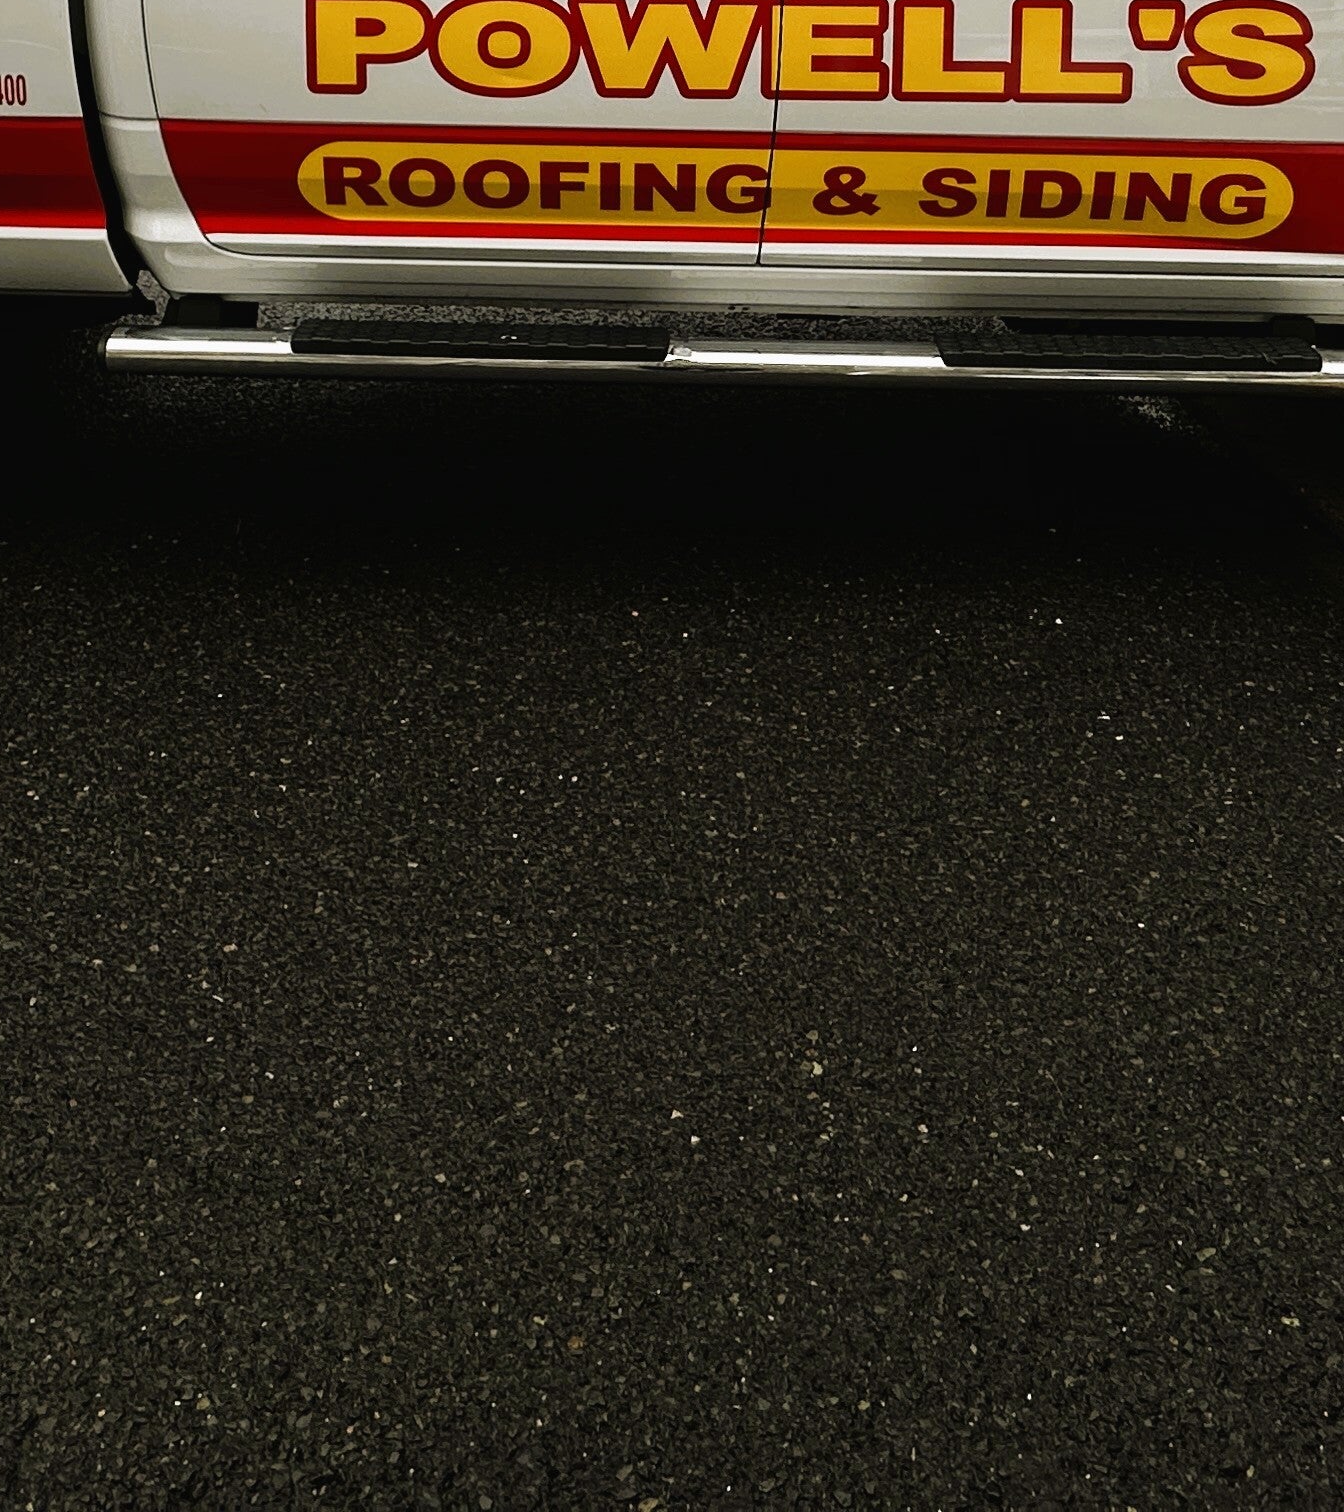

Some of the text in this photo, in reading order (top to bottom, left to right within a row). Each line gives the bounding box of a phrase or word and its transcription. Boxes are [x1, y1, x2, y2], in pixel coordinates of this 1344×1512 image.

[322, 156, 1268, 225] ROOFING & SIDING
